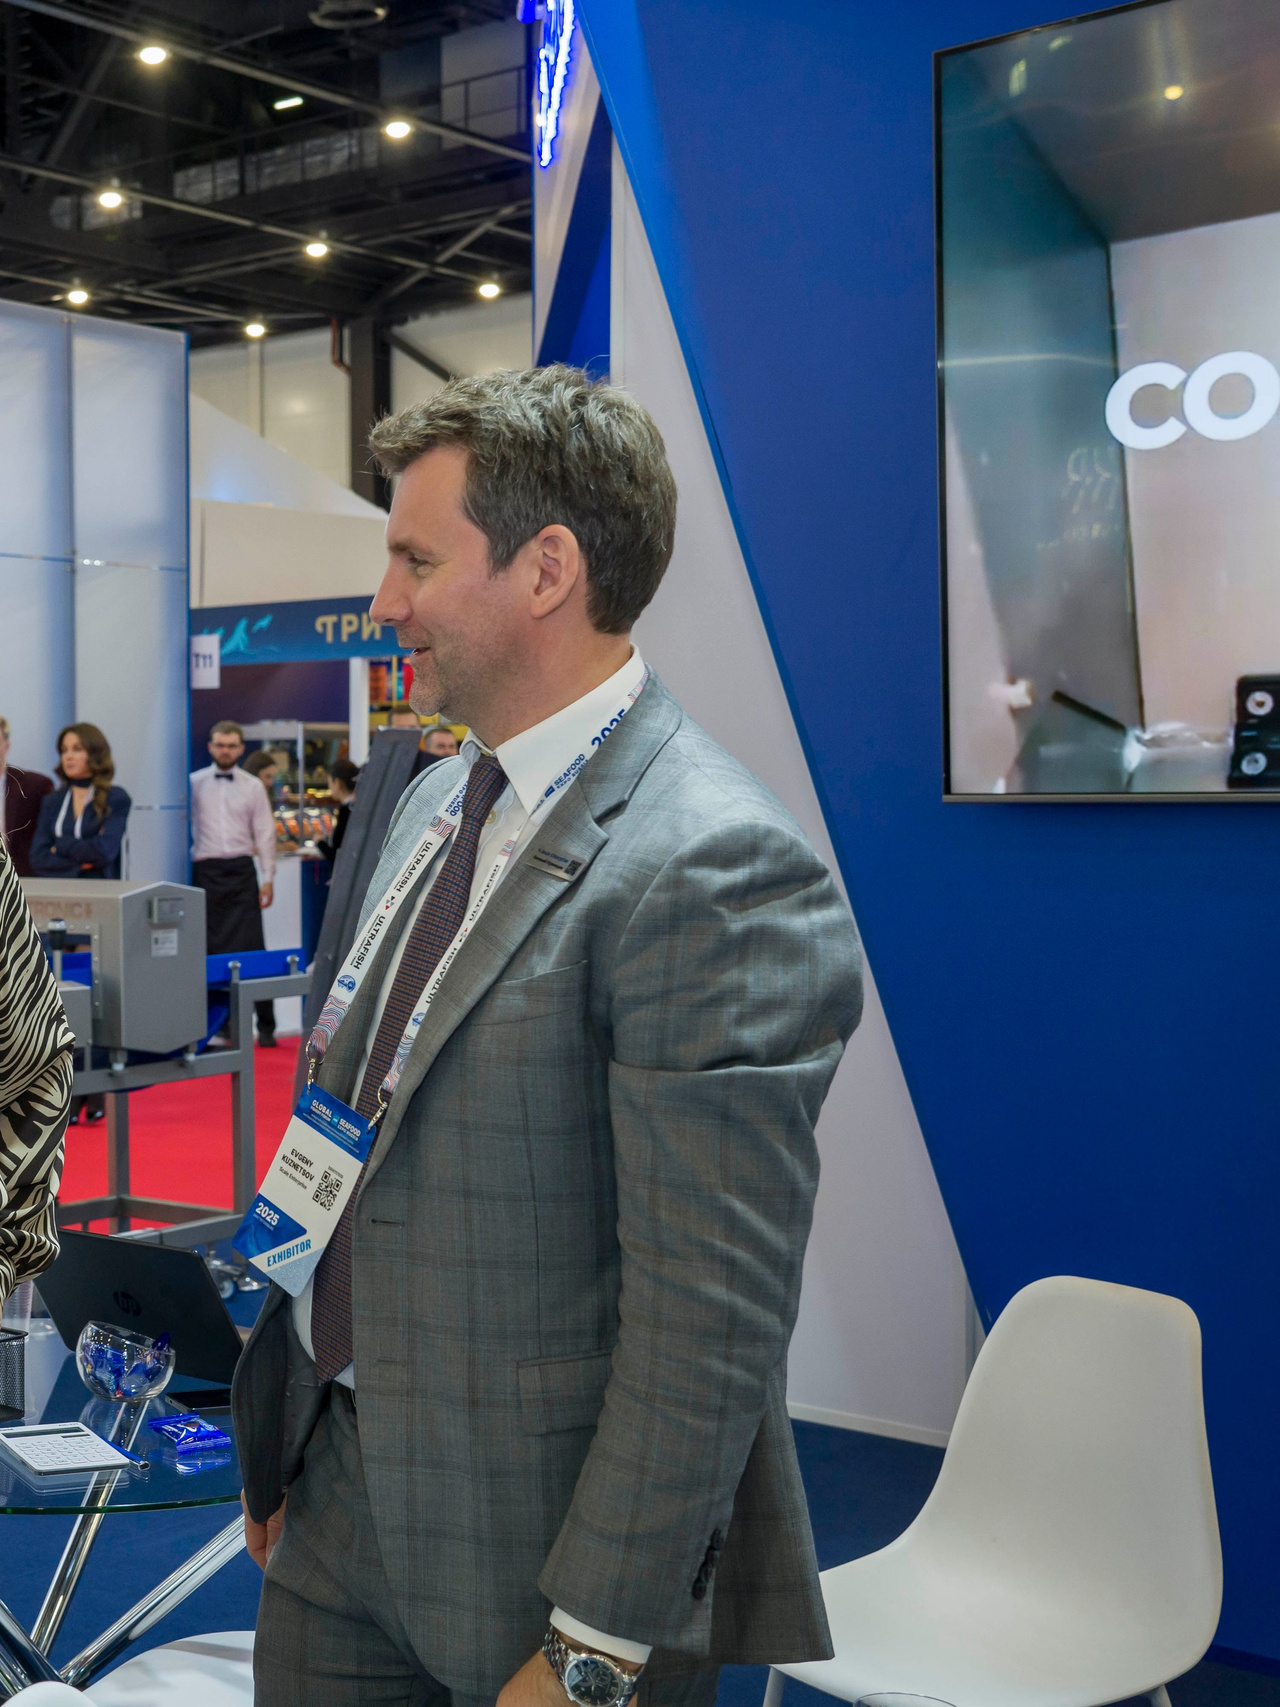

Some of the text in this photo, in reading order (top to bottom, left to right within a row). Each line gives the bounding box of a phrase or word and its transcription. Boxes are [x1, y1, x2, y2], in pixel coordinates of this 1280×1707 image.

[554, 753, 585, 786] SEAFOOD
[396, 841, 434, 893] ULTRAFISH
[469, 864, 500, 922] ULTRAFISH
[353, 915, 386, 970] ULTRAFISH
[425, 947, 458, 1005] ULTRAFISH
[311, 1099, 333, 1118] GLOBAL
[339, 1118, 362, 1137] SEAFOOD
[279, 1166, 290, 1177] Scale
[281, 1154, 315, 1182] KUZNETSOV
[290, 1148, 314, 1168] EVGENY
[255, 1202, 280, 1226] 2025
[266, 1238, 312, 1268] EXHIBITOR
